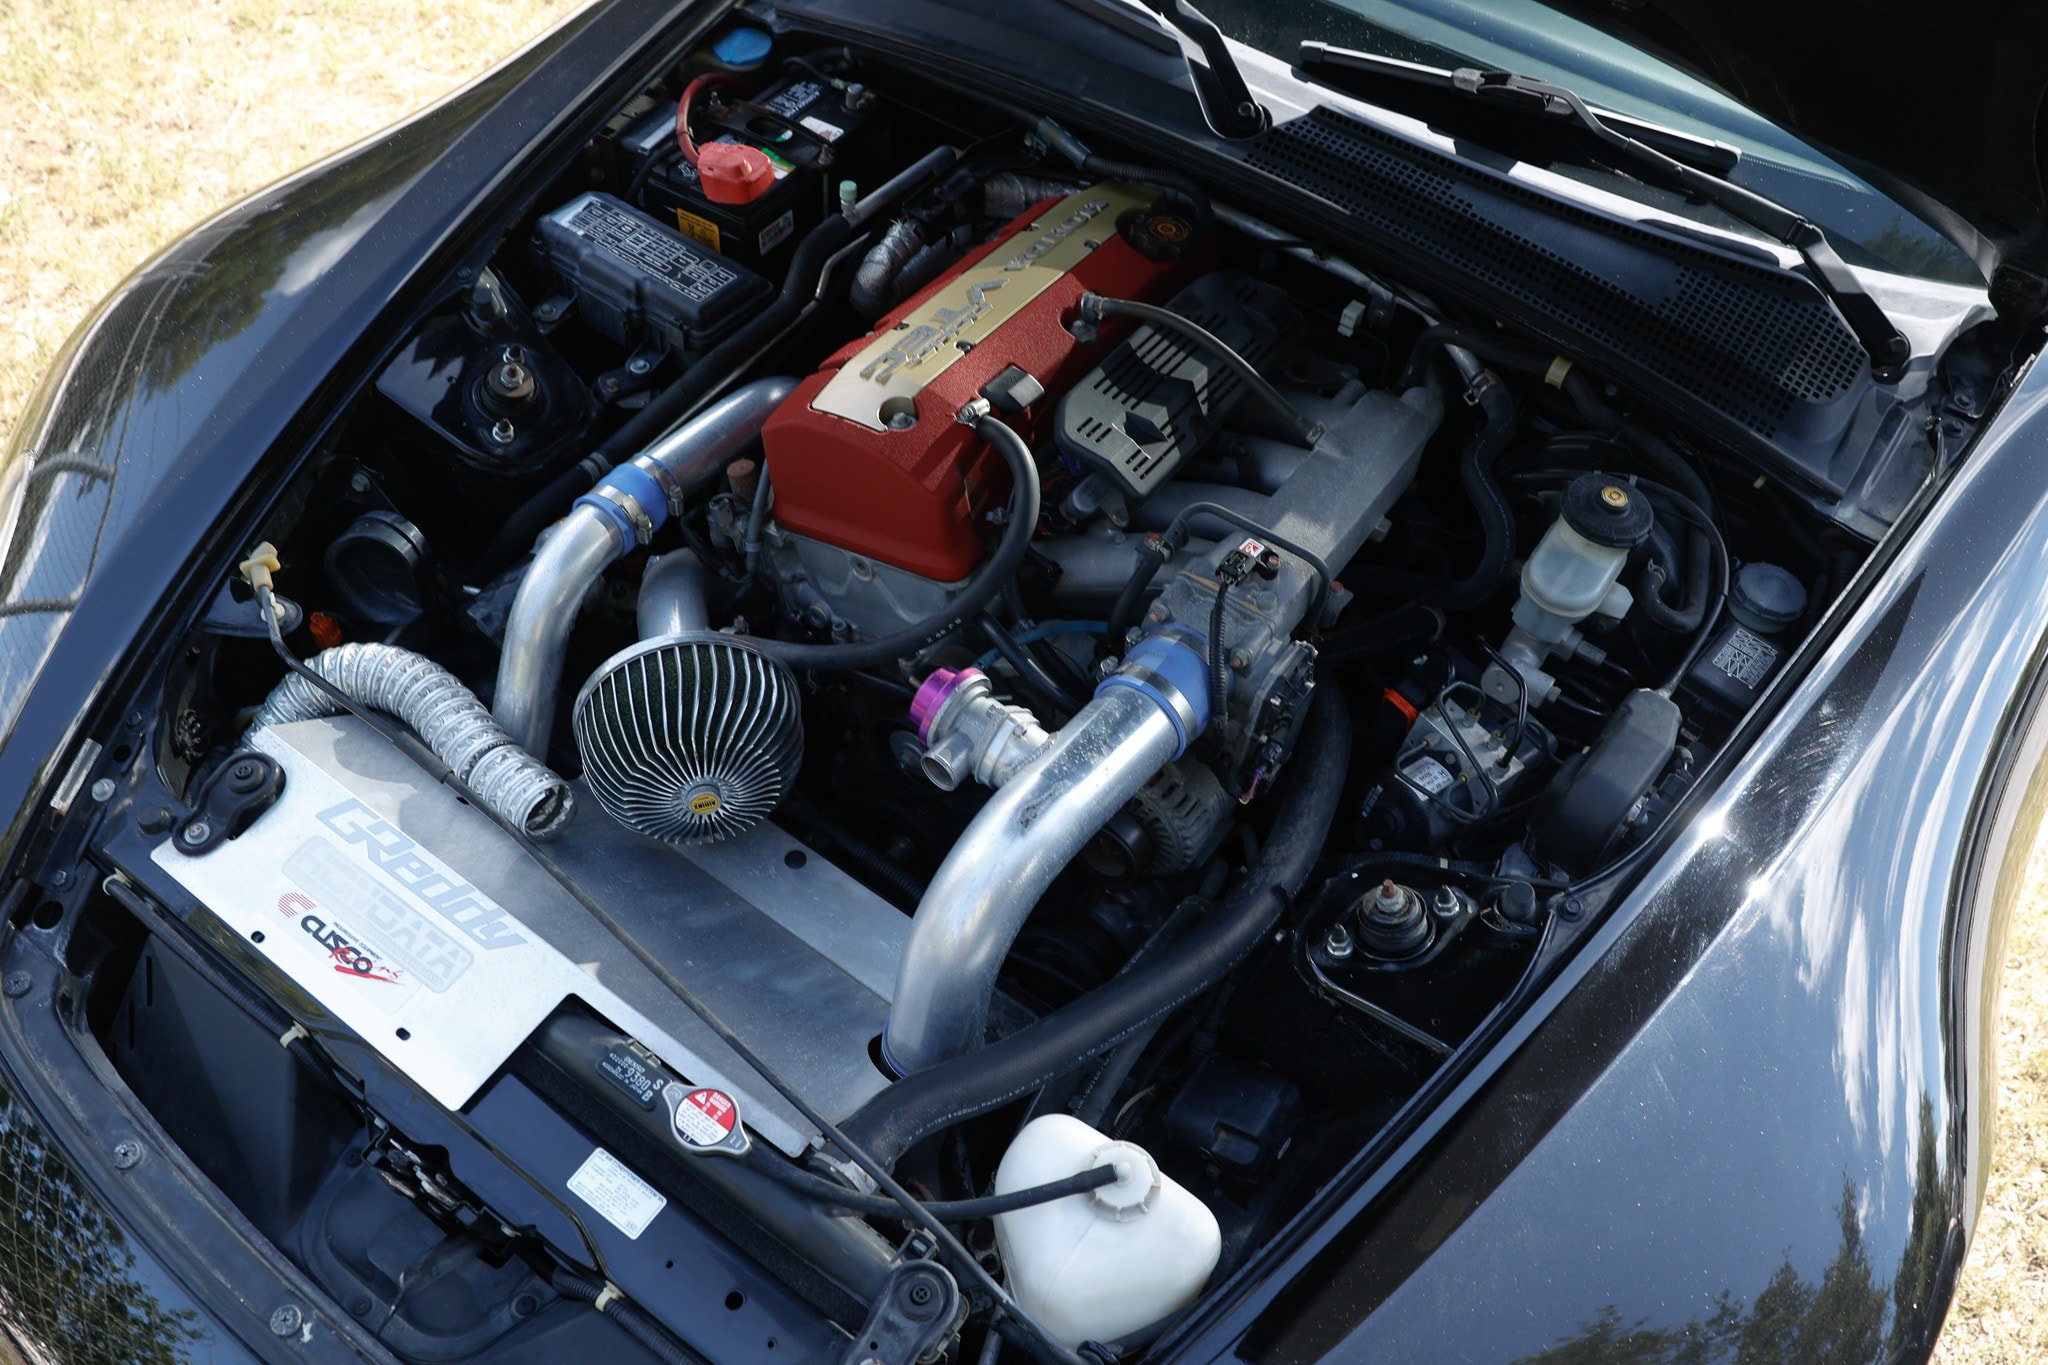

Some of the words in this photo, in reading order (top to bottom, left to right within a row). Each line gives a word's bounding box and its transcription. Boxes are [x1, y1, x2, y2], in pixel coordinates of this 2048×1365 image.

[860, 279, 1010, 385] VTEC
[296, 842, 460, 980] HONDATA
[651, 1077, 664, 1091] S
